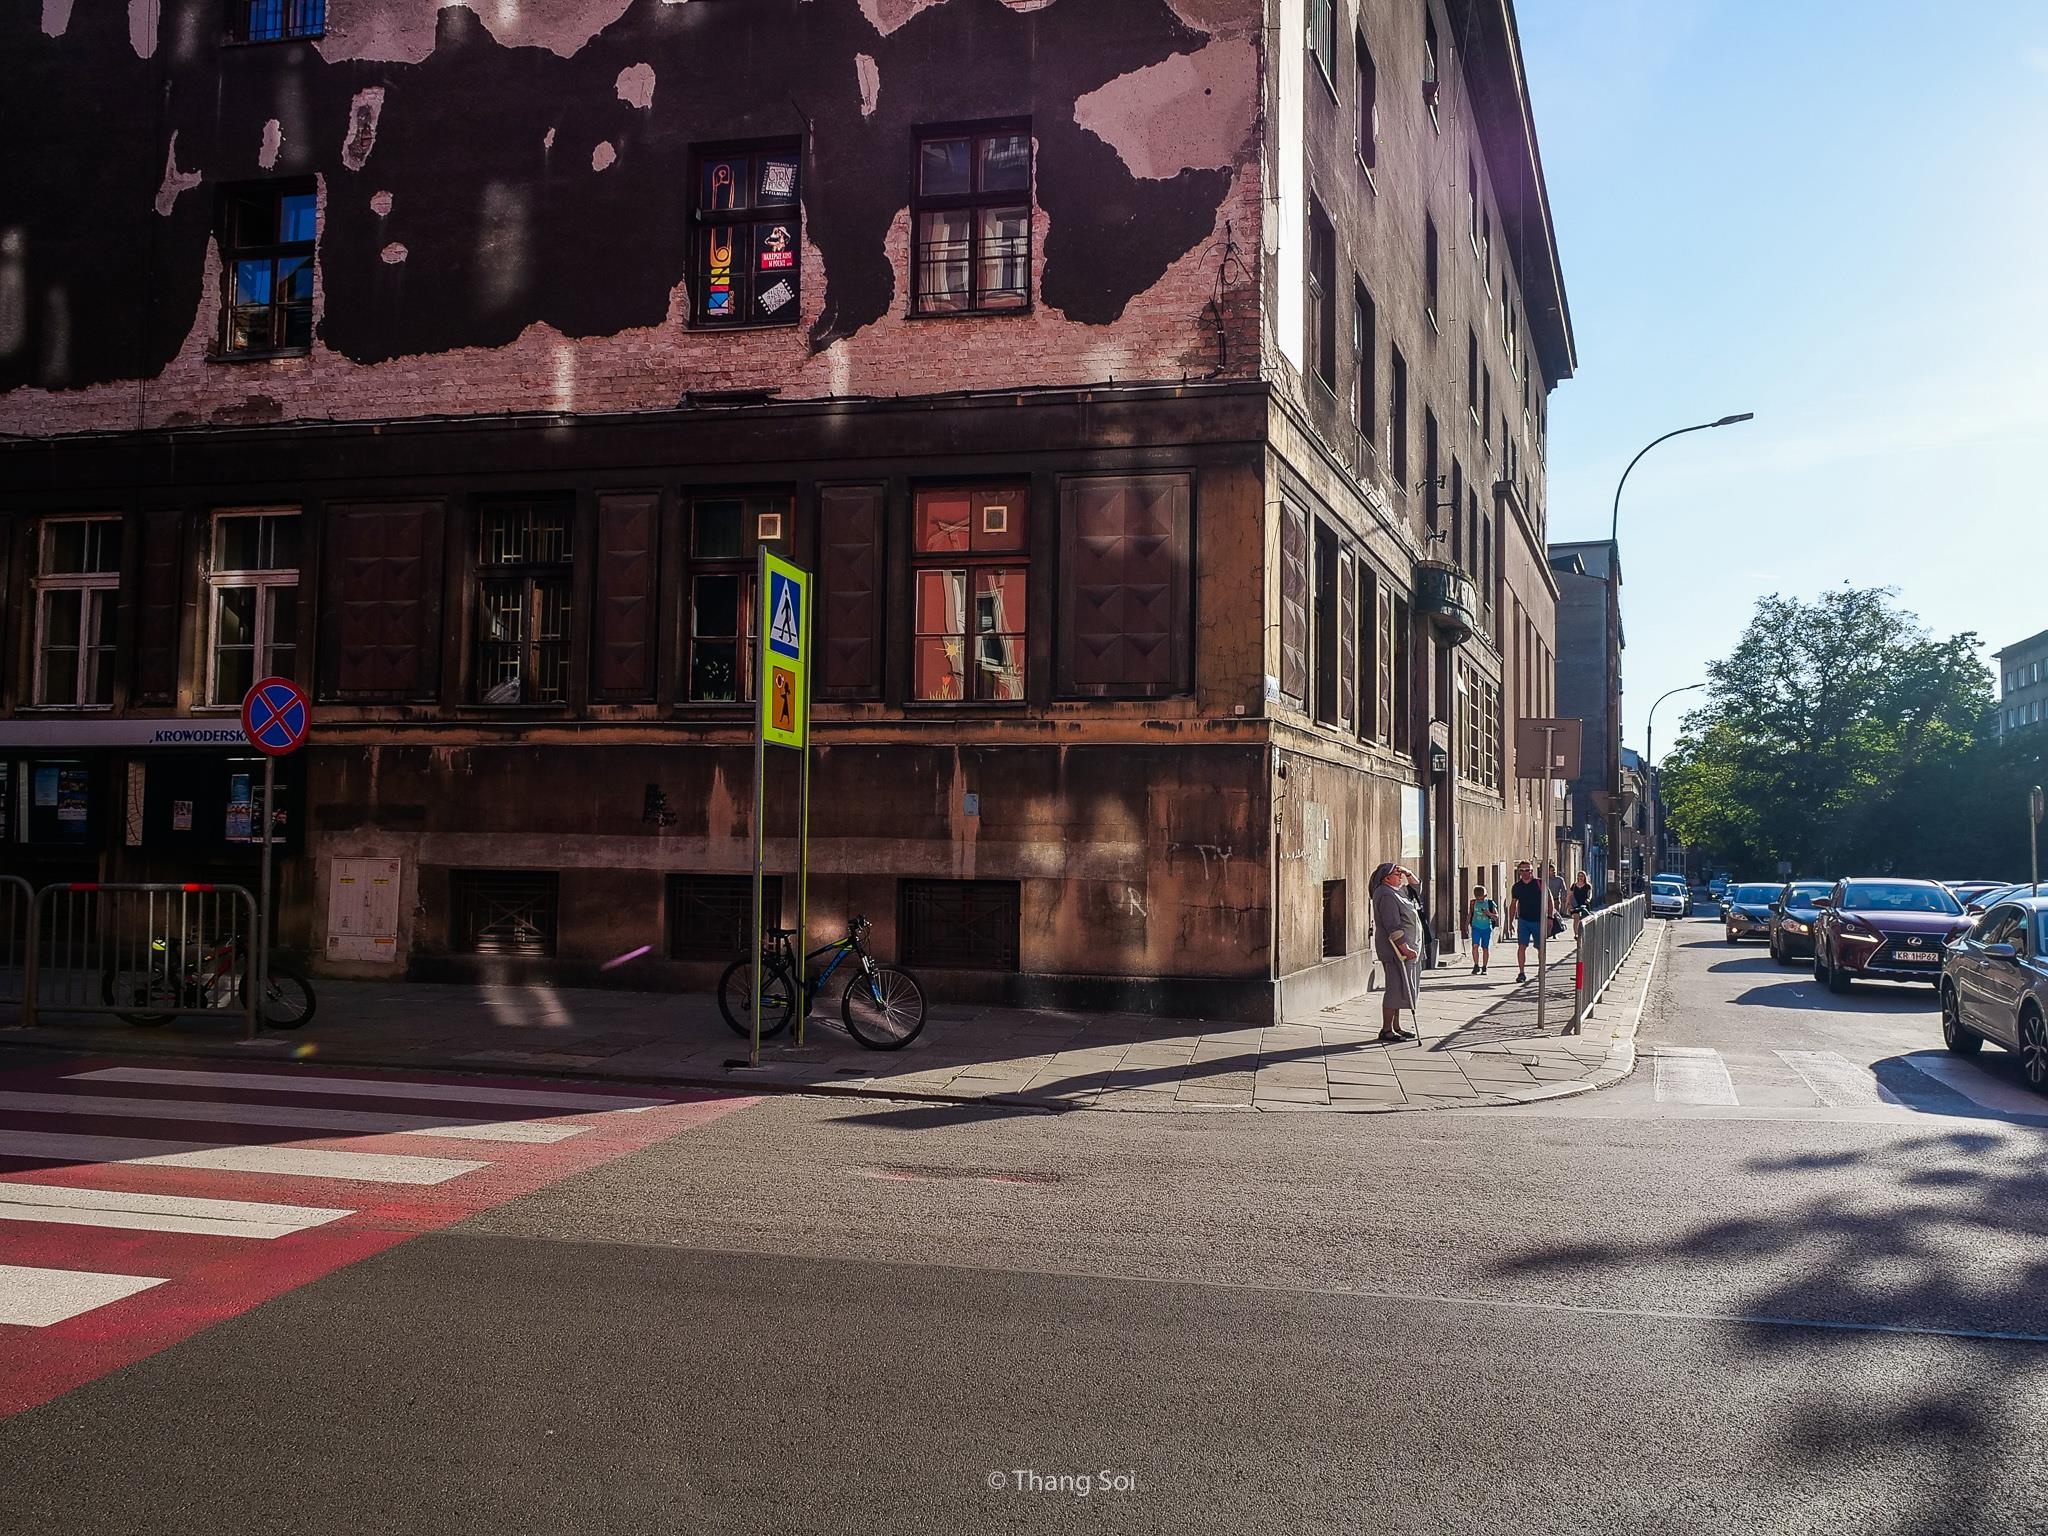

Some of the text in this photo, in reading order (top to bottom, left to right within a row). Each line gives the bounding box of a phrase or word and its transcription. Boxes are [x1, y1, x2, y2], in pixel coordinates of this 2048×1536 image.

[155, 729, 249, 742] KROWODERSK
[1897, 952, 1937, 961] KR 1HP62
